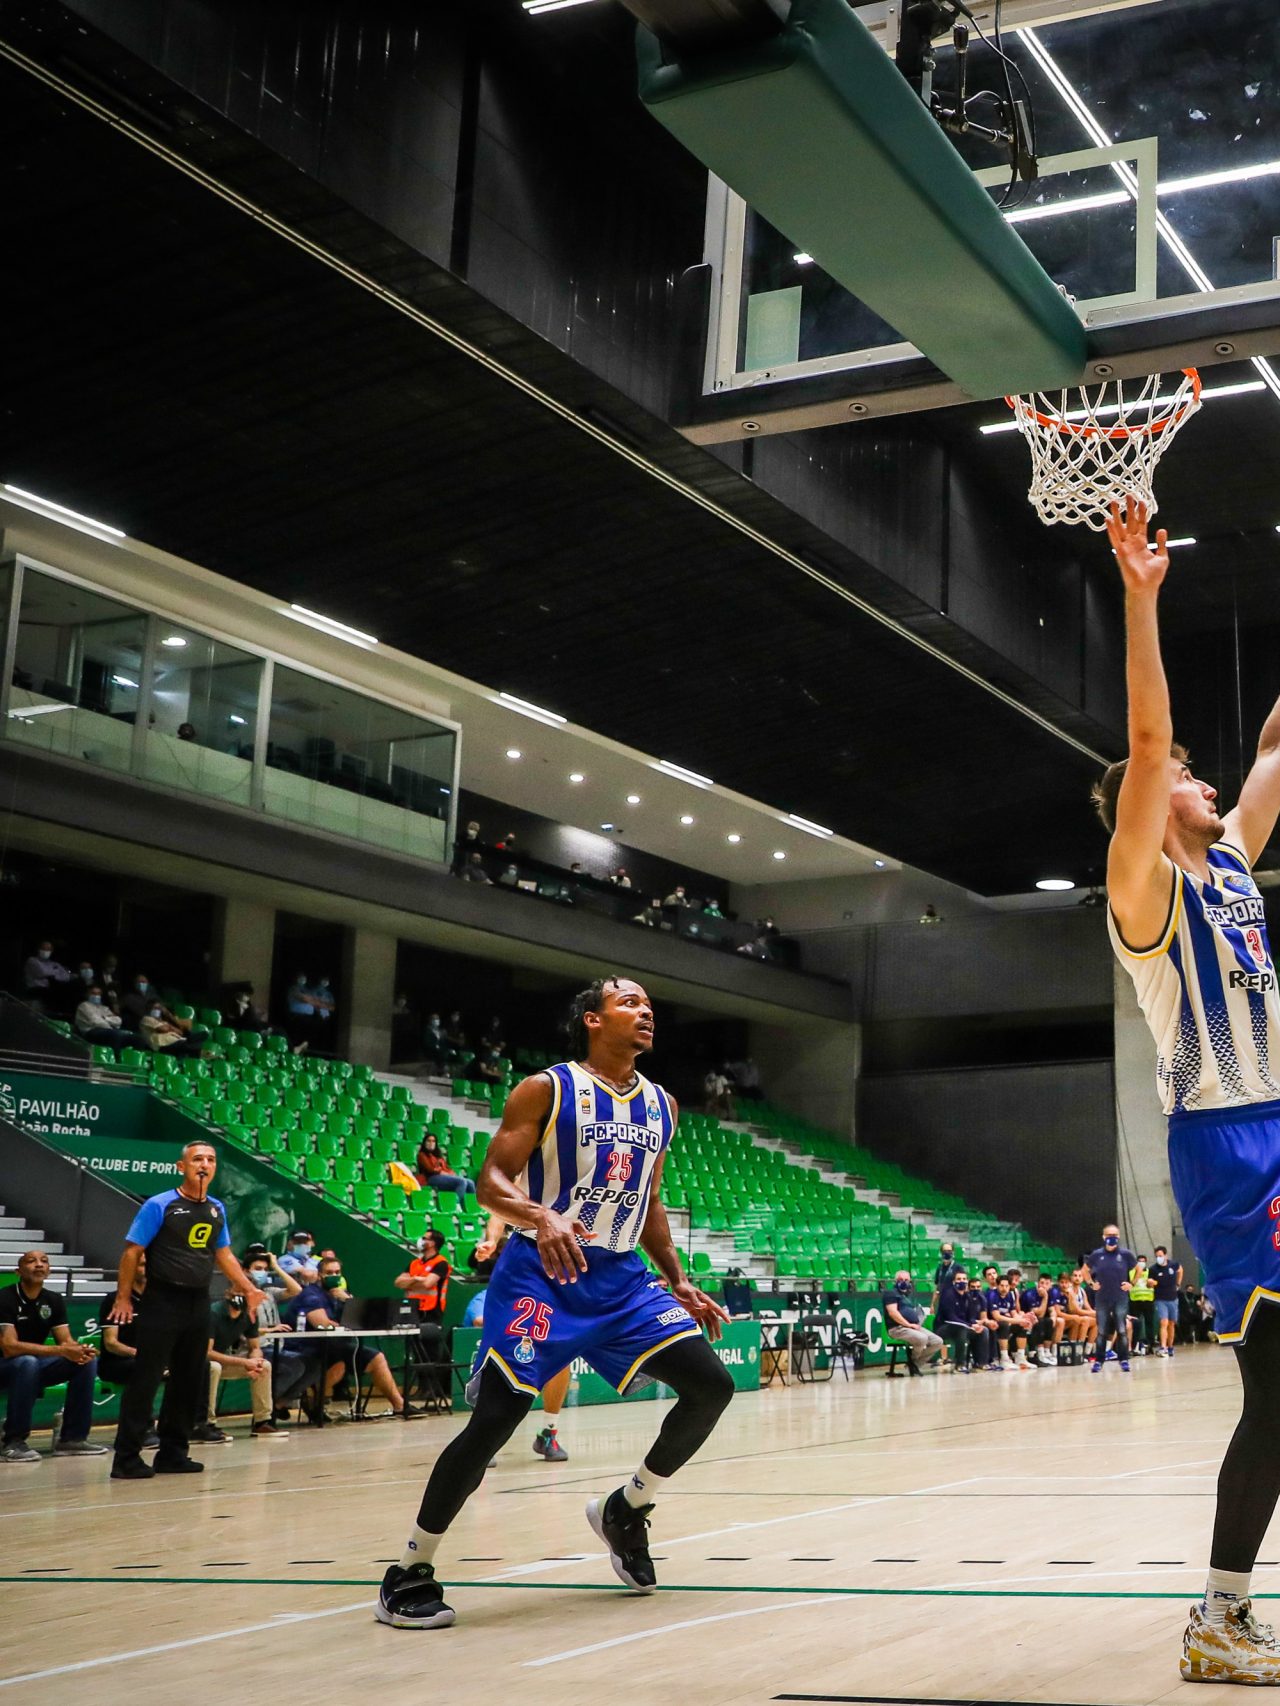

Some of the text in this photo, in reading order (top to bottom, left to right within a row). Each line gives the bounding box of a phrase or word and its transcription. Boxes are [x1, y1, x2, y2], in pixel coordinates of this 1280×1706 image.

[19, 1099, 100, 1121] PAVILHÃO
[91, 1157, 130, 1172] CLUBE
[132, 1160, 147, 1173] DE
[607, 1151, 633, 1182] 25
[195, 1226, 207, 1240] G
[505, 1296, 554, 1341] 25
